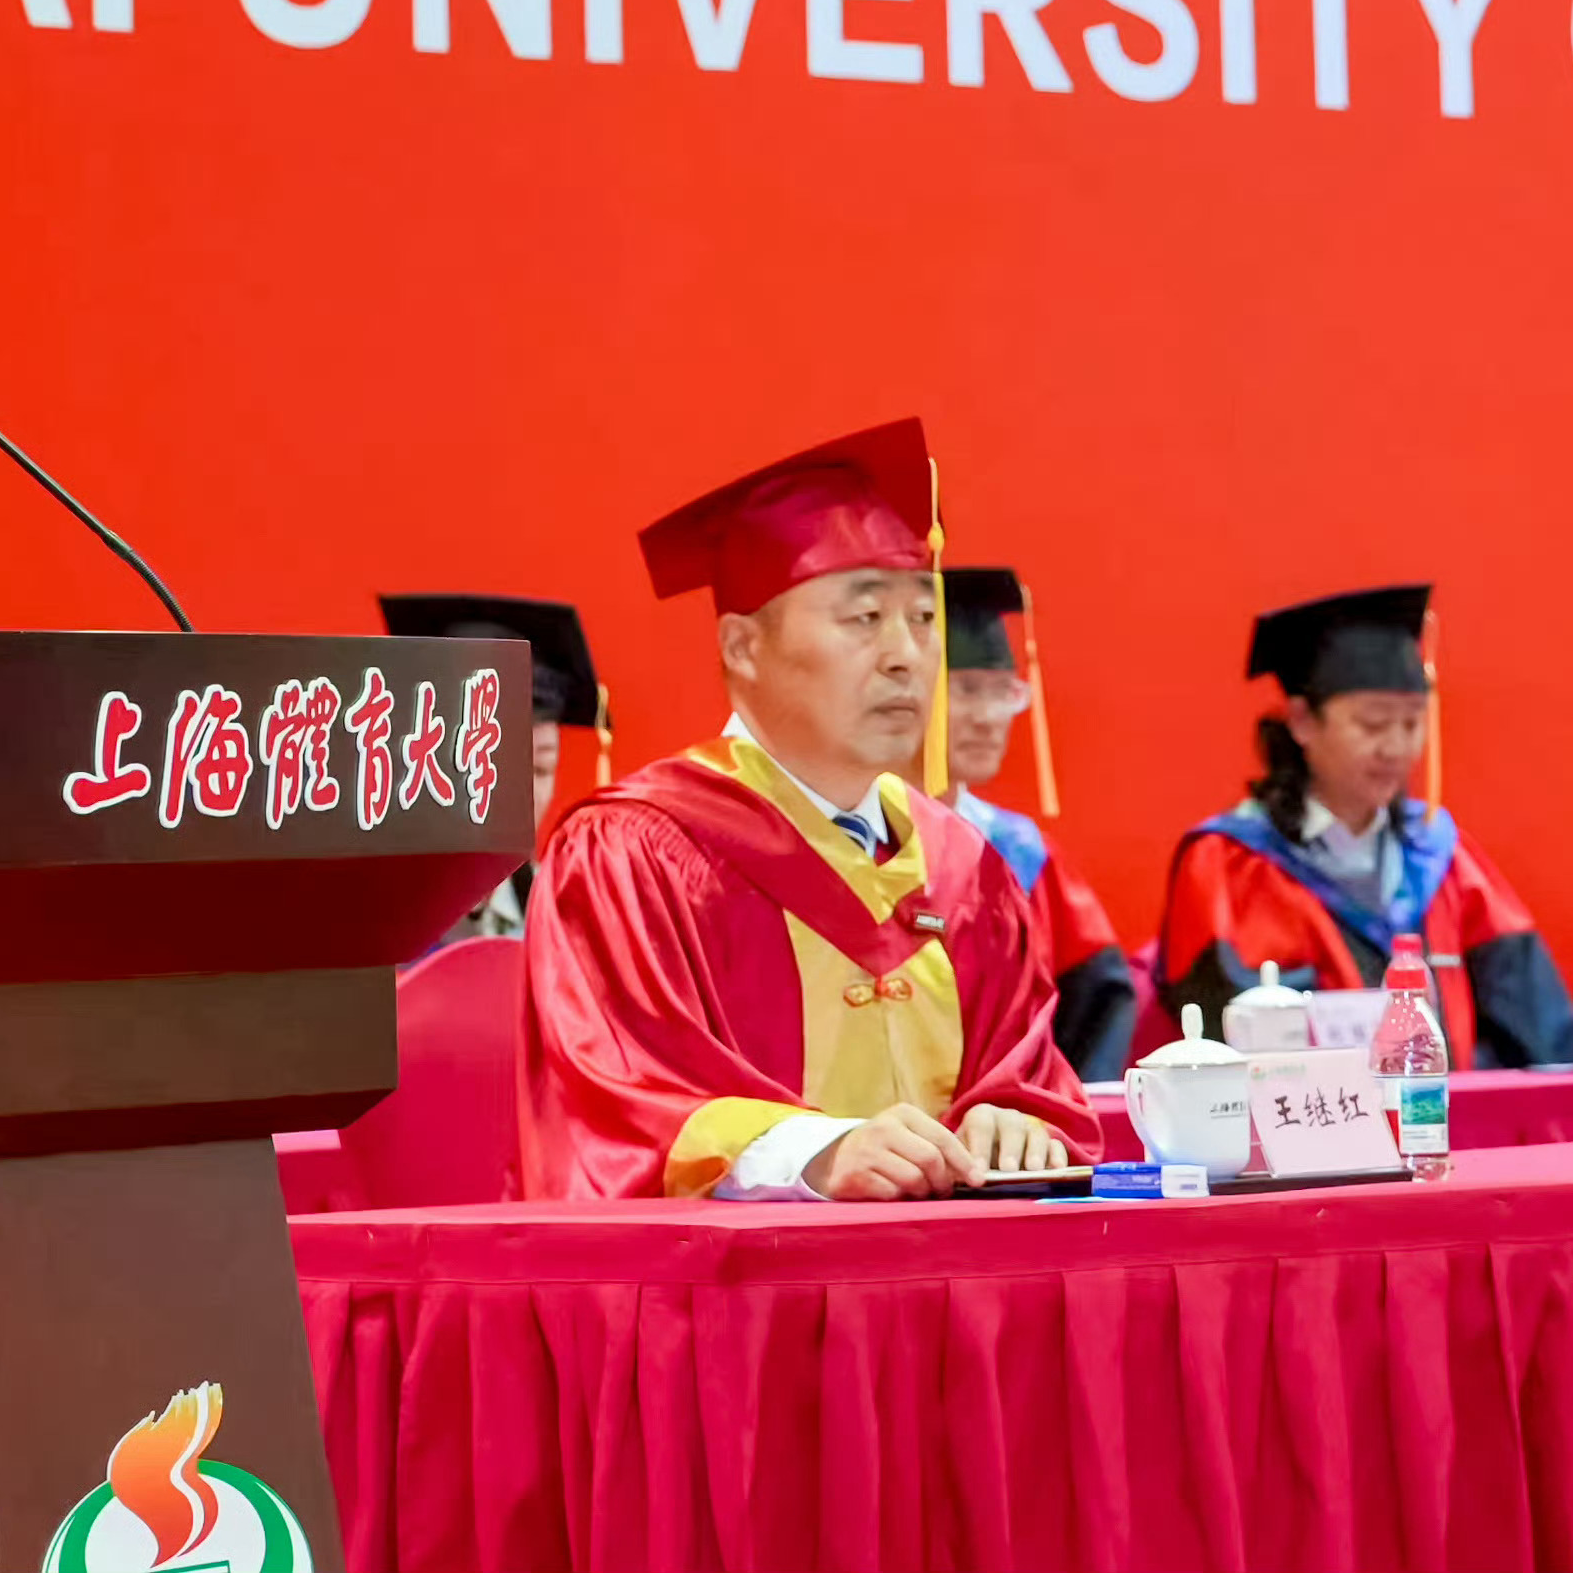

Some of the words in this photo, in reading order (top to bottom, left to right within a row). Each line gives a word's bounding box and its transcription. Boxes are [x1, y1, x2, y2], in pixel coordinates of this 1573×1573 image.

[62, 666, 502, 831] 上海體育大學
[1274, 1087, 1369, 1129] 王继红
